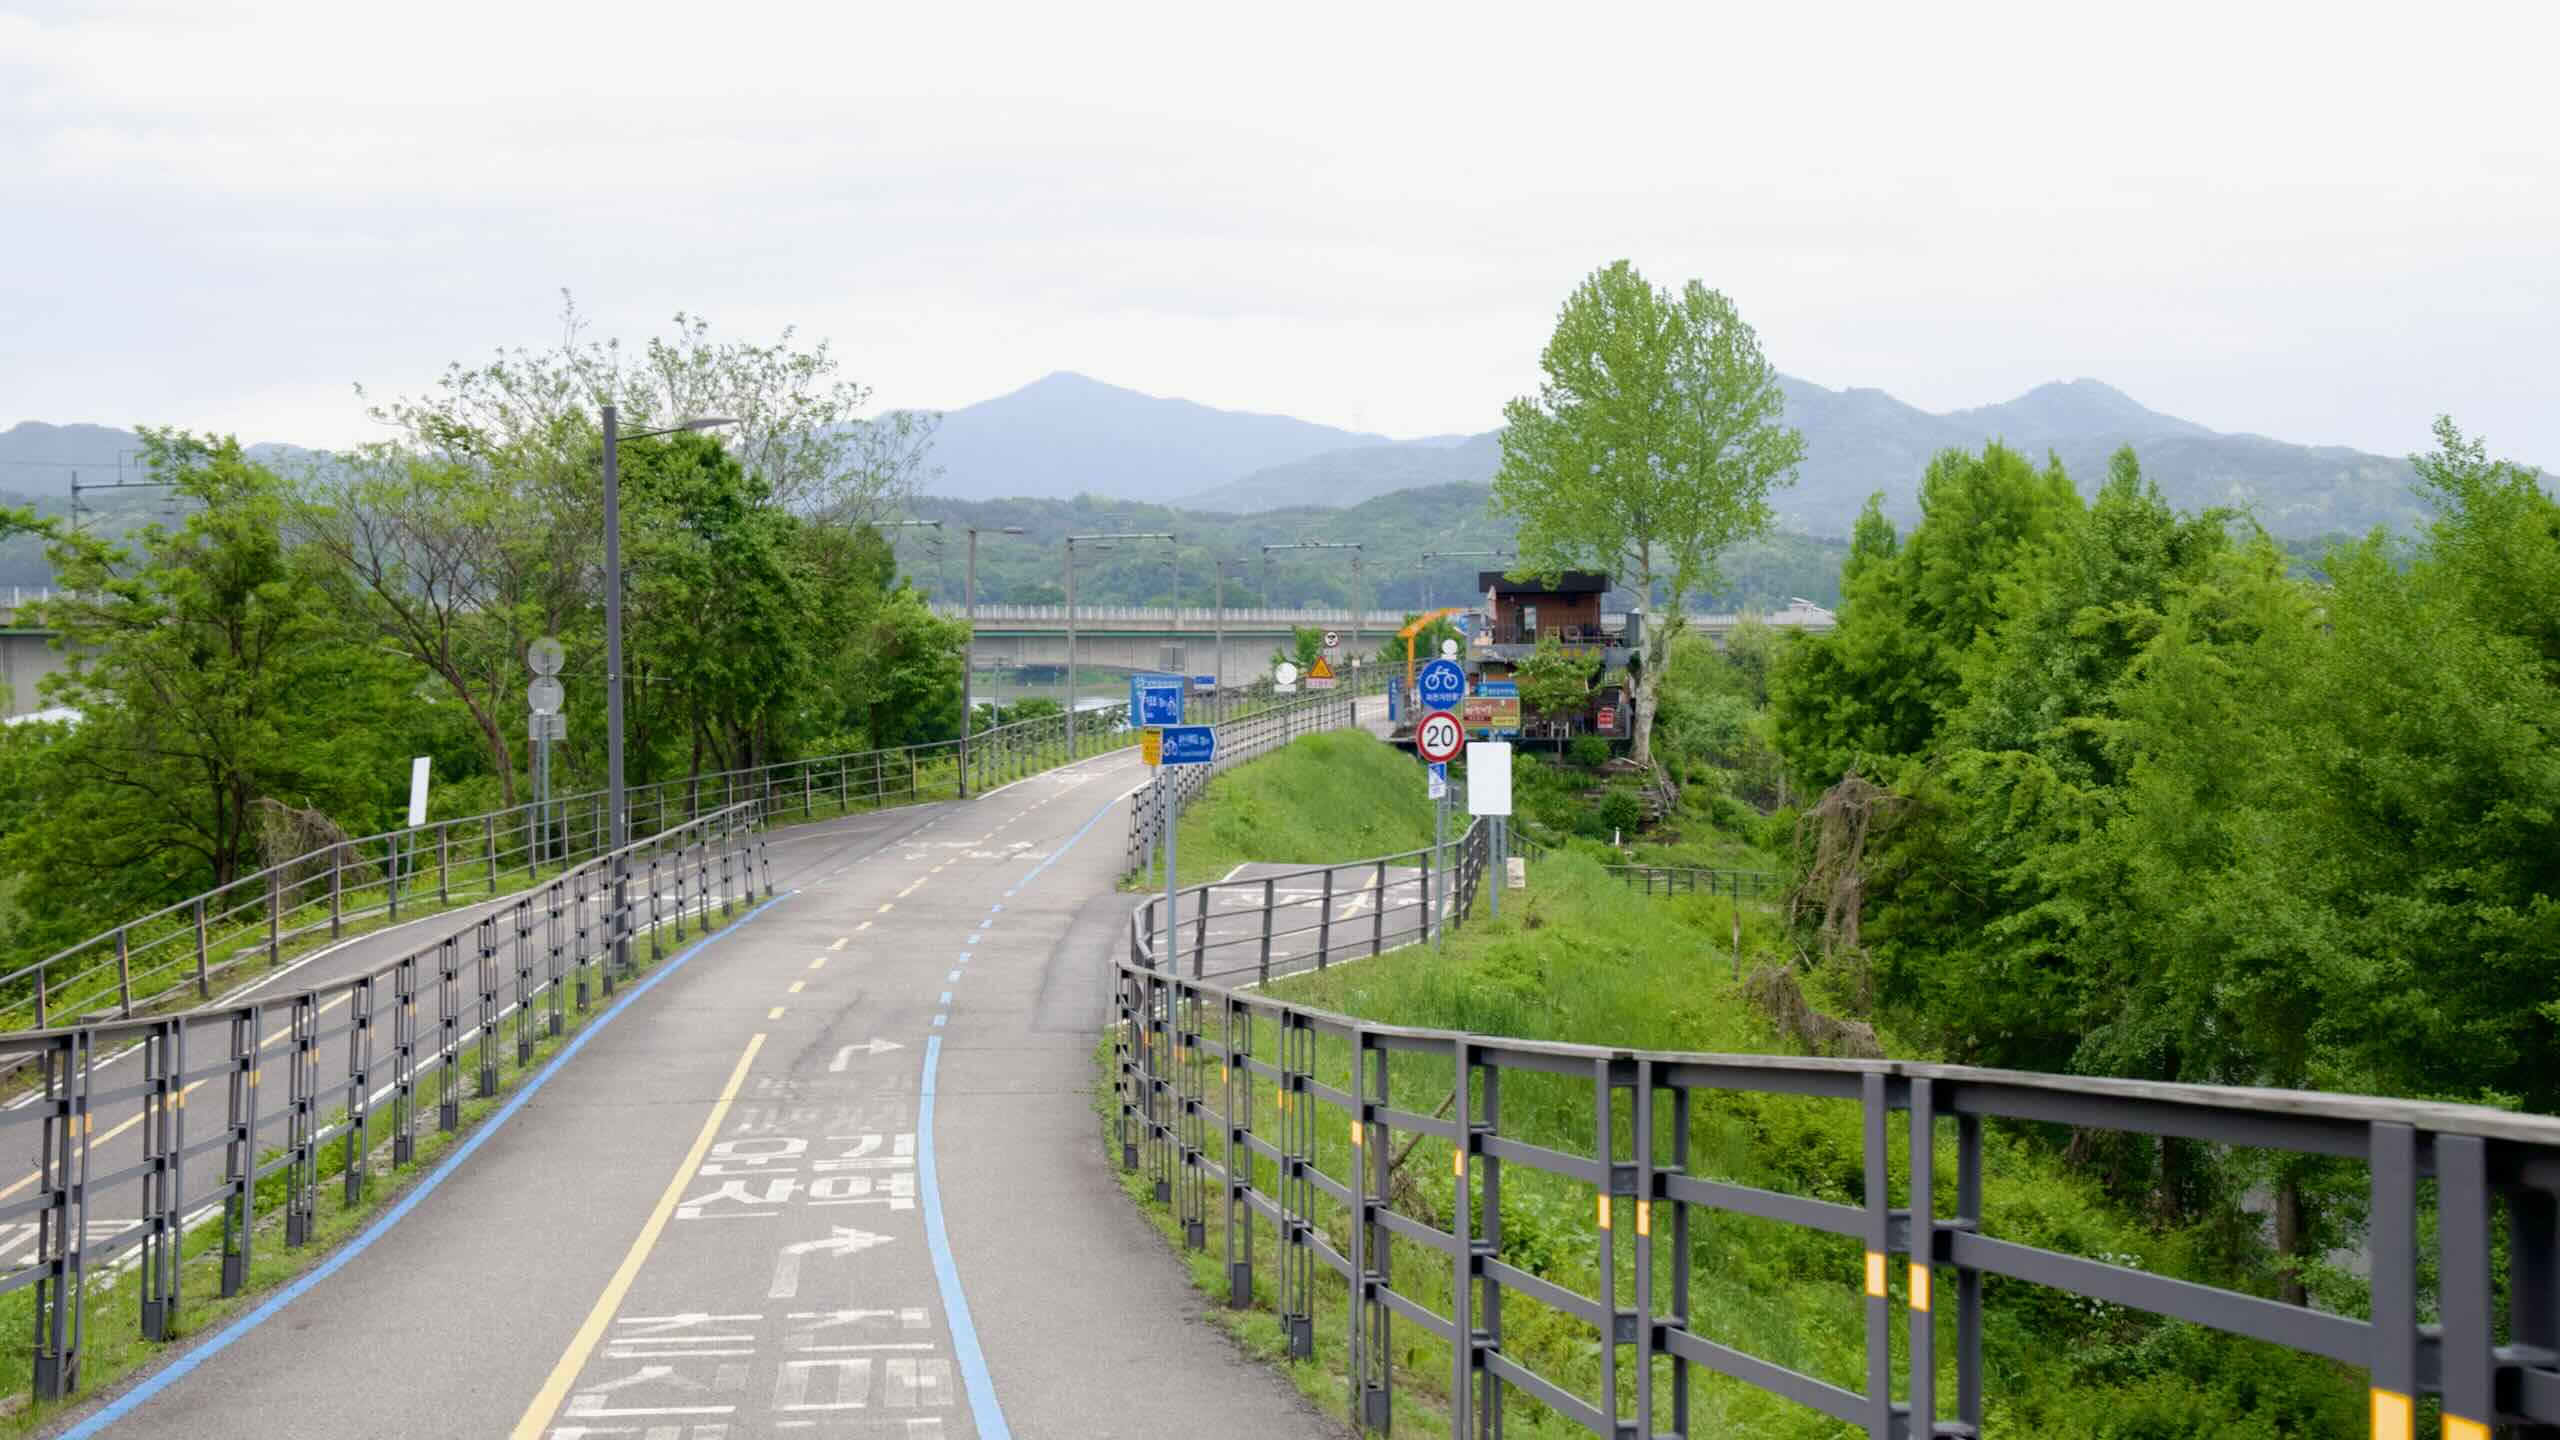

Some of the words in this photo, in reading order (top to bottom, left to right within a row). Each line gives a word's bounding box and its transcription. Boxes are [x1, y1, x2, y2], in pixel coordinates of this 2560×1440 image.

[1427, 725, 1454, 747] 20
[700, 1134, 915, 1174] 운길
[675, 1174, 915, 1219] 산역
